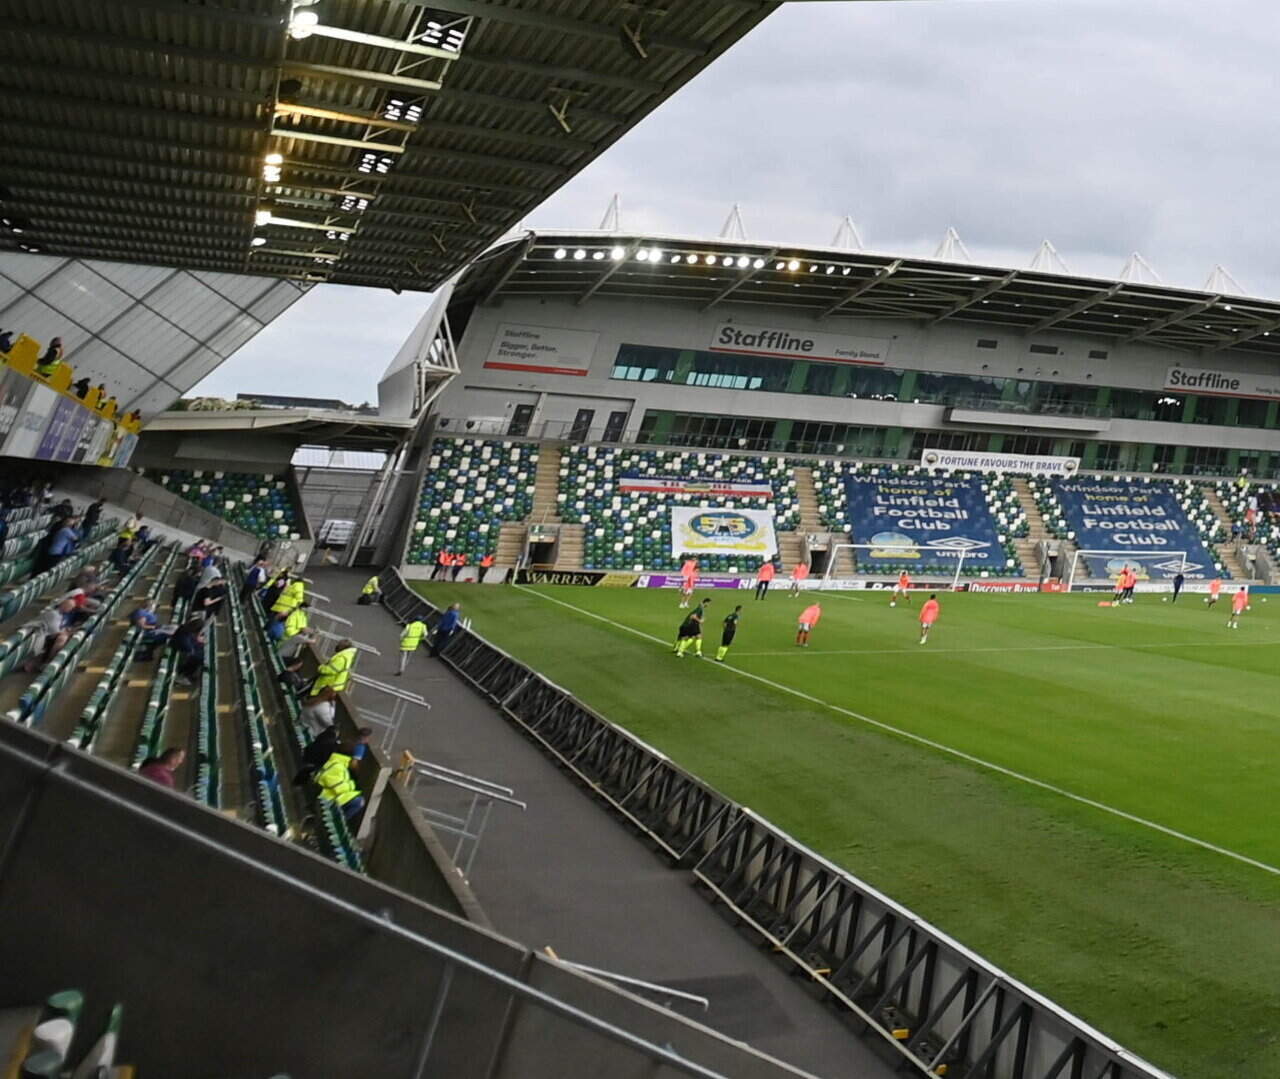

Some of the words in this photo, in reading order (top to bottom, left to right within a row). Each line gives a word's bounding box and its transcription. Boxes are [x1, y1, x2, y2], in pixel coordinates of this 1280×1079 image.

[719, 327, 814, 351] Staffline
[835, 349, 858, 358] Family
[1170, 370, 1240, 390] Staffline
[940, 456, 978, 466] FORTUNE
[980, 457, 1018, 468] FAVOURS
[1020, 460, 1035, 469] THE
[1036, 461, 1063, 471] BRAVE
[853, 475, 926, 487] Windsor
[933, 479, 971, 489] Park
[878, 485, 923, 496] home
[931, 489, 953, 497] of
[1059, 484, 1124, 494] Windsor
[1129, 485, 1162, 495] Park
[877, 495, 960, 509] Linfield
[1085, 493, 1129, 502] home
[1133, 494, 1148, 502] of
[873, 507, 968, 520] Football
[1082, 504, 1167, 517] Linfield
[898, 519, 950, 531] Club
[1083, 518, 1180, 531] Football
[1113, 532, 1168, 546] Club
[525, 572, 595, 585] WARREN
